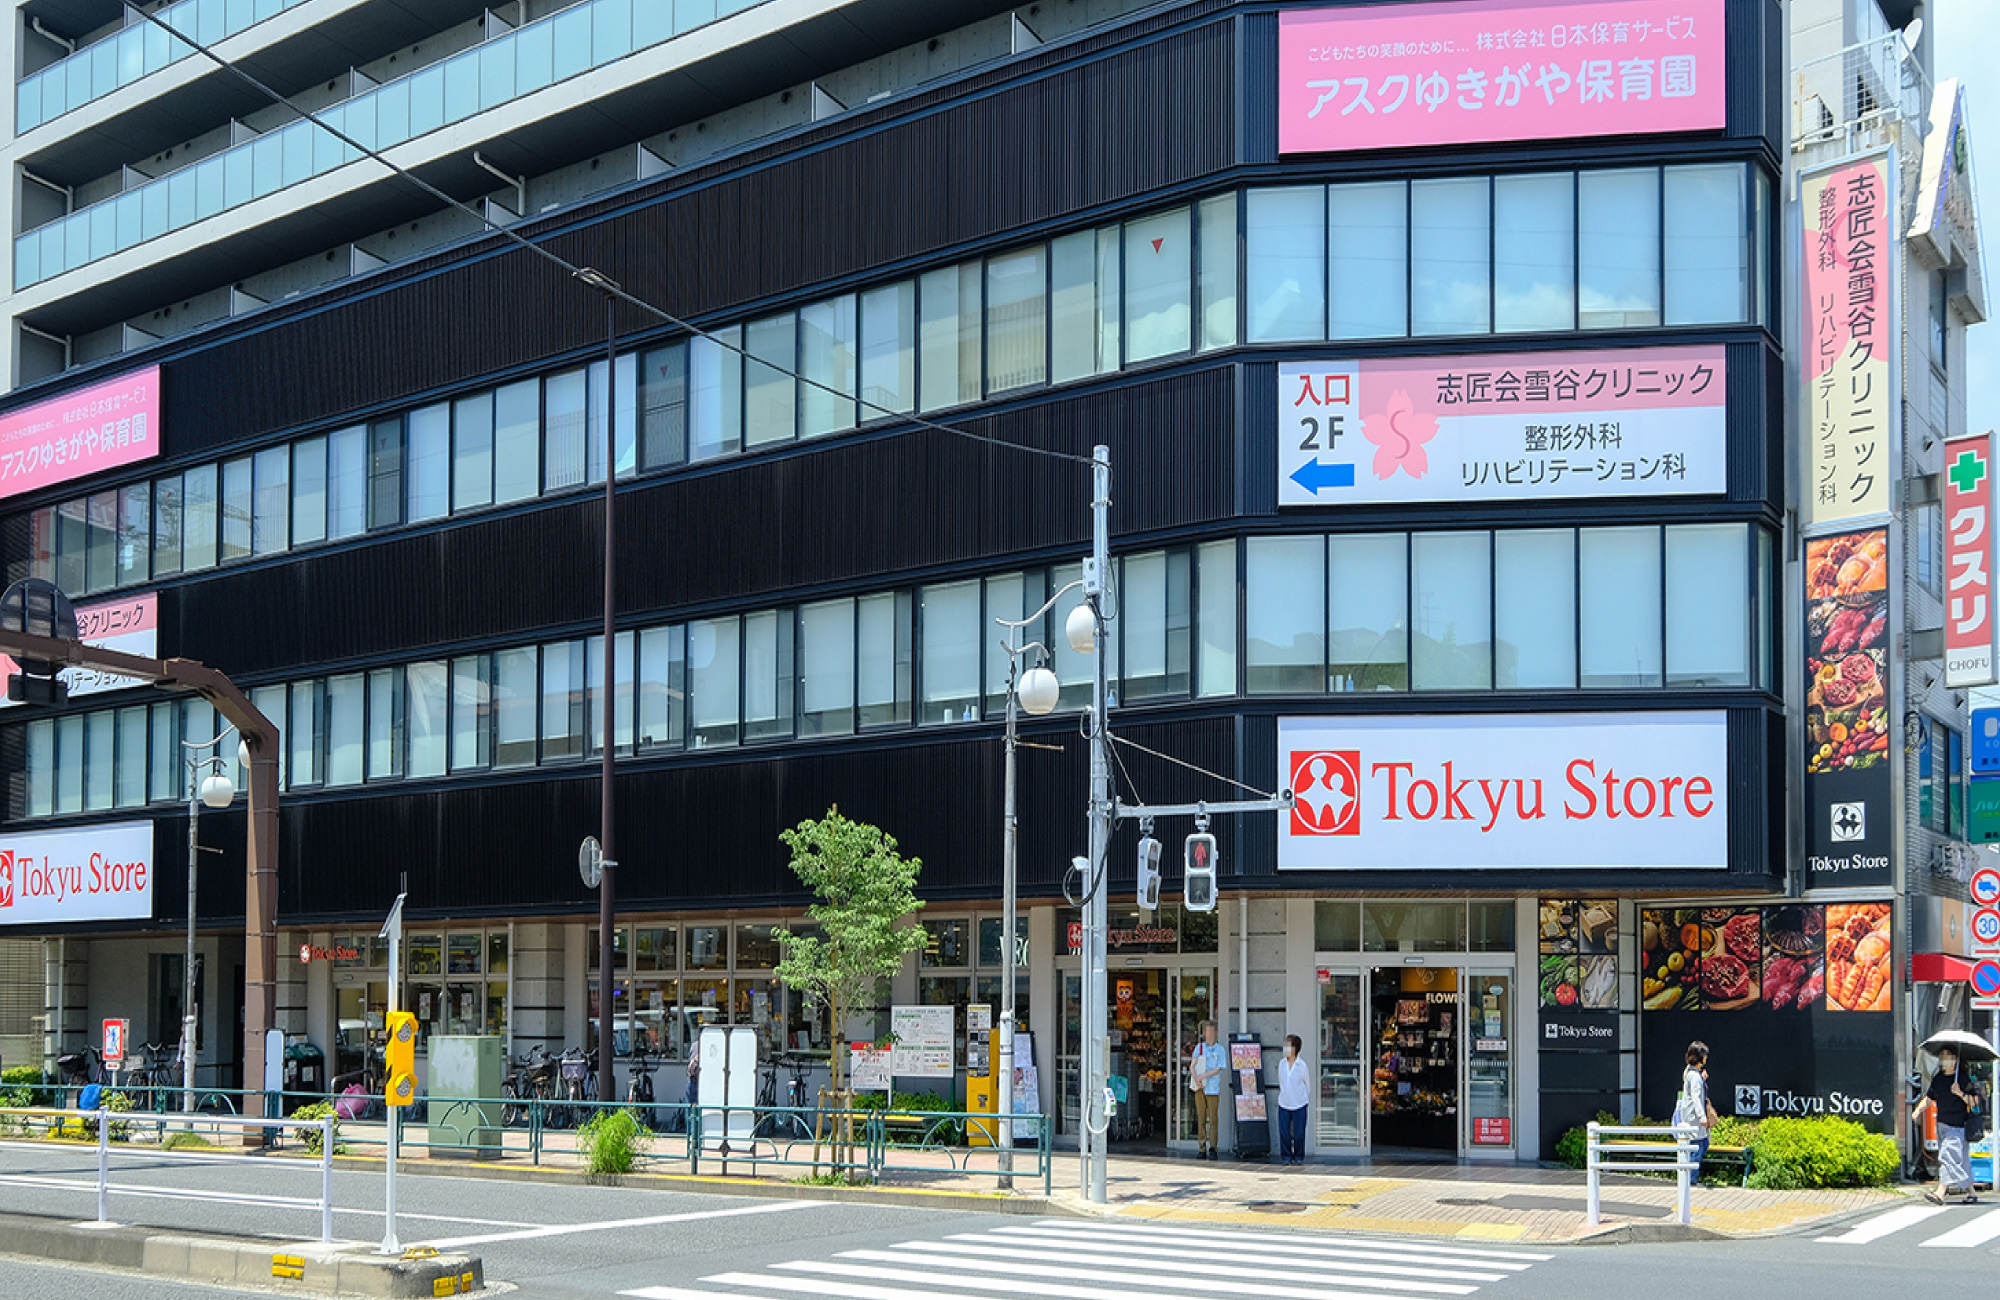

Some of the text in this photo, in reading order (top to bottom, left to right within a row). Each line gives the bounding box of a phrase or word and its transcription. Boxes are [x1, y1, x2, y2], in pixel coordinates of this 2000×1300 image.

[1475, 28, 1546, 52] 株式会社
[1551, 16, 1697, 49] 日本保育サービス
[1305, 53, 1697, 120] アスクゆきがや保育園
[1818, 186, 1837, 506] 整形外科 リハビリテーション科
[1847, 173, 1876, 503] 志匠会雪谷クリニック
[1294, 373, 1351, 407] 入口
[1436, 364, 1714, 405] 志匠会雪谷クリニック
[1, 411, 147, 481] アスクゆきがや保育園
[1298, 415, 1345, 451] 2F
[1524, 422, 1623, 452] 整形外科
[1461, 453, 1687, 487] リハビリテーション科
[1949, 505, 1987, 635] クスリ
[1948, 657, 1990, 672] CHOFU
[1371, 757, 1714, 833] Tokyu Store
[18, 852, 147, 904] Tokyu Store
[1808, 853, 1889, 873] Tokyu Store
[1135, 923, 1176, 943] Store
[1978, 917, 1998, 935] 30
[311, 944, 358, 962] Tokyu Store
[1558, 1025, 1614, 1039] Tokyu Store
[1762, 1089, 1884, 1117] Tokyu Store
